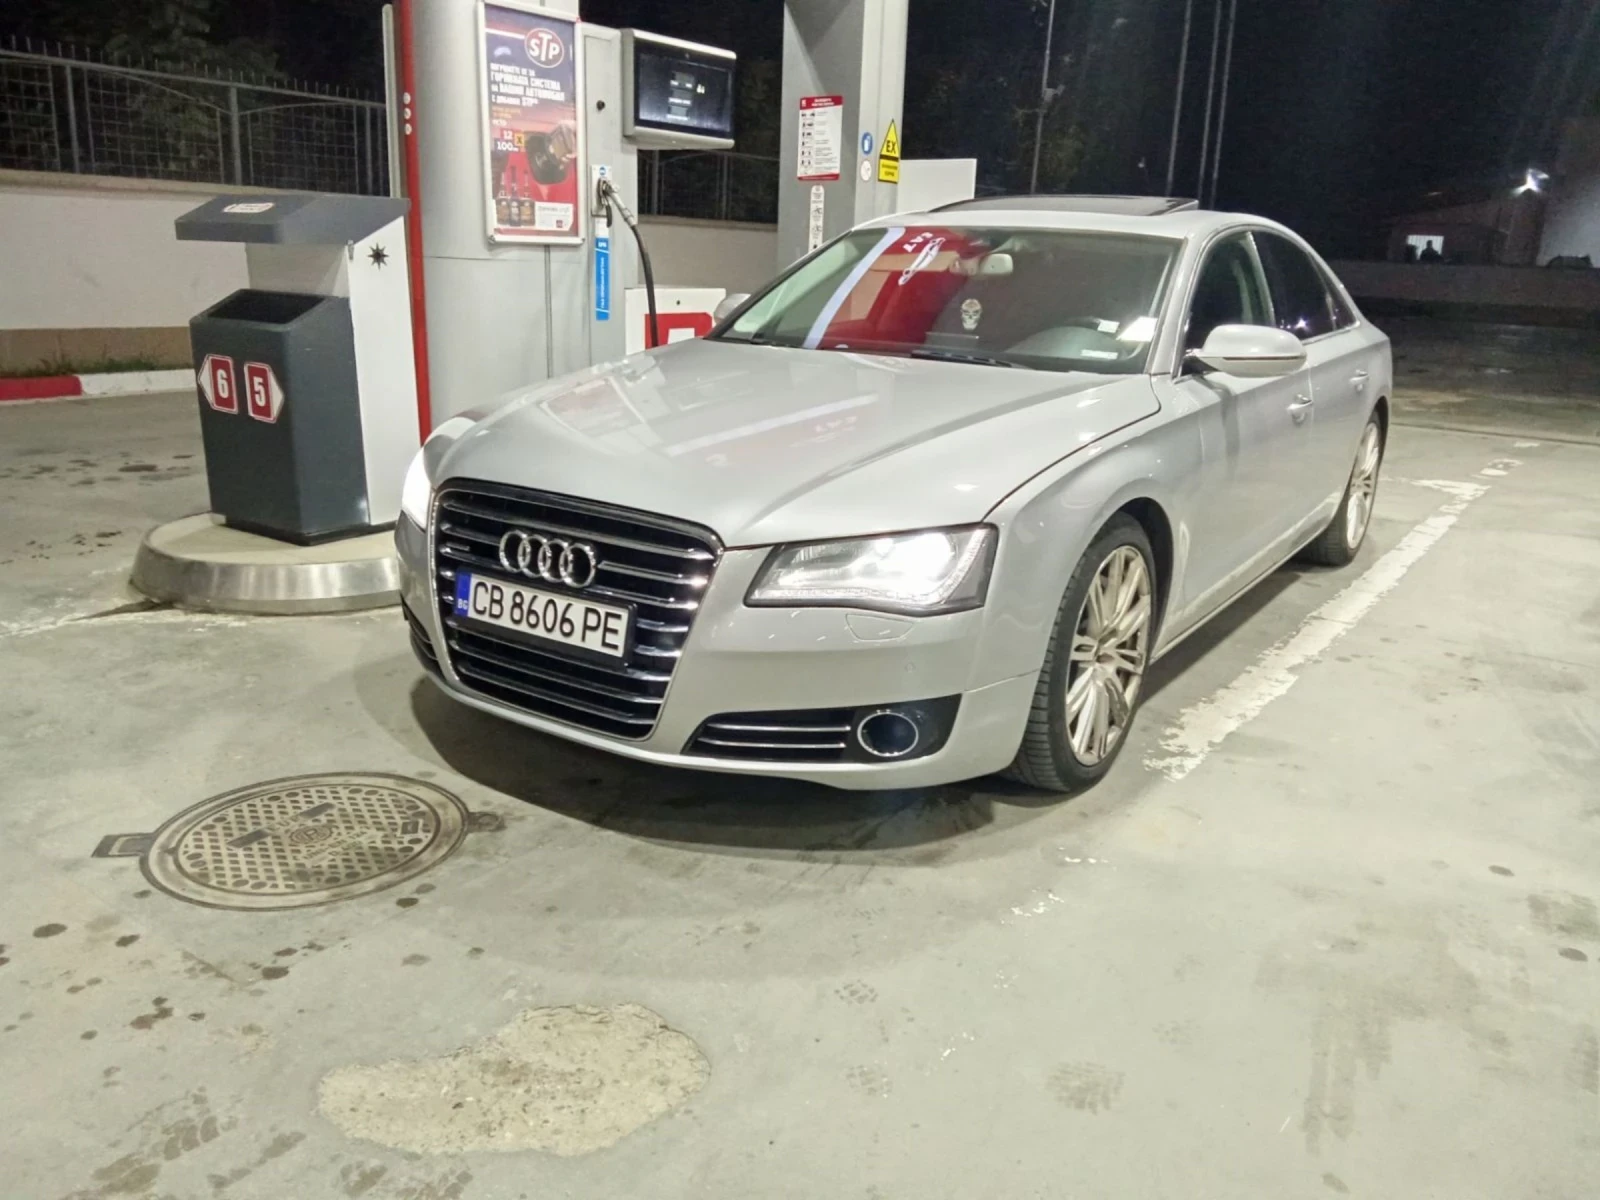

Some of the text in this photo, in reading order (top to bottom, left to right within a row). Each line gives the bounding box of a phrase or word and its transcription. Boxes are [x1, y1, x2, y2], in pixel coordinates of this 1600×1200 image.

[530, 32, 560, 61] STP
[886, 140, 896, 154] EX
[216, 369, 229, 399] 6
[253, 376, 266, 407] 5
[457, 598, 469, 610] BG
[473, 581, 622, 650] CB 8606 PE
